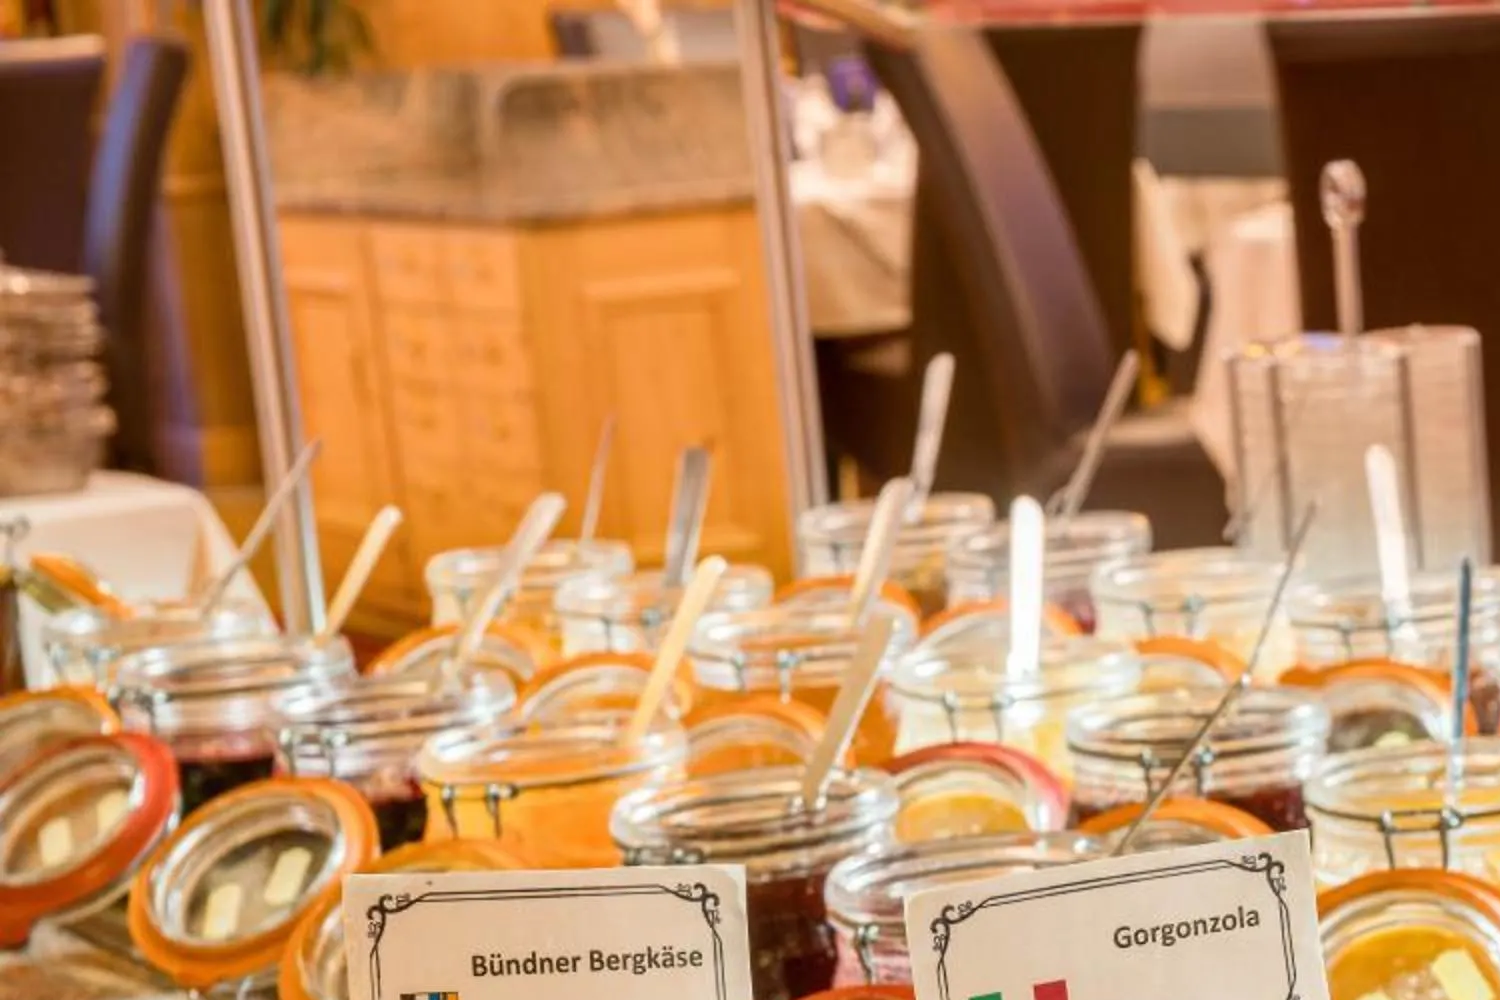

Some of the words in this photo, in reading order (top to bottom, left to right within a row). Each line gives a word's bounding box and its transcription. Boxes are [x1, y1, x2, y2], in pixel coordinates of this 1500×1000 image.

[1112, 905, 1261, 950] Gorgonzola
[471, 949, 582, 978] Bündner
[588, 944, 704, 978] Bergkäse
